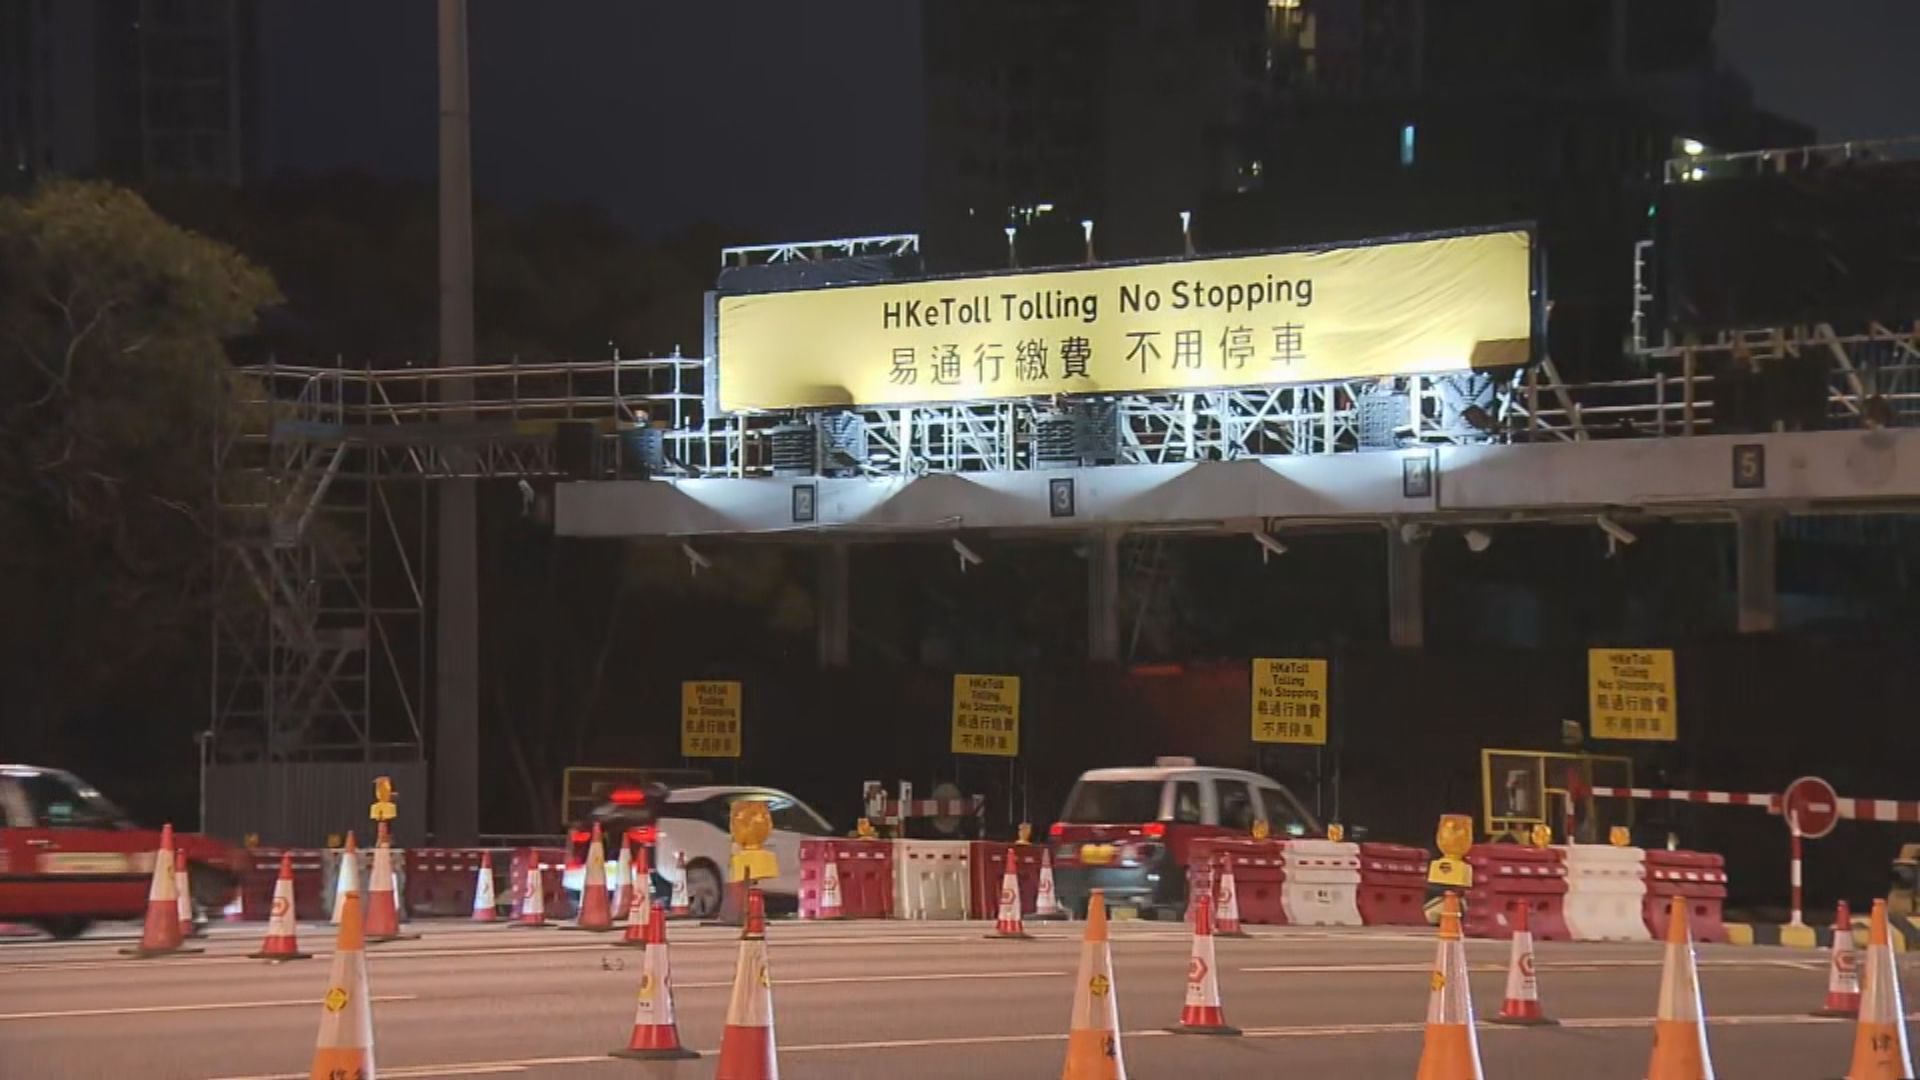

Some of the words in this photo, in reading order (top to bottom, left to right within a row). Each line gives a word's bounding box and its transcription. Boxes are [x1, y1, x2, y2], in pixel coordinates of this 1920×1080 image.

[883, 296, 992, 329] HKeToll
[1000, 290, 1098, 323] Tolling
[1119, 284, 1161, 313] No
[1172, 274, 1313, 312] Stopping
[889, 336, 1092, 385] 易通行繳費
[1125, 321, 1307, 374] 不用停車
[1742, 452, 1757, 478] 5
[1056, 486, 1070, 509] 3
